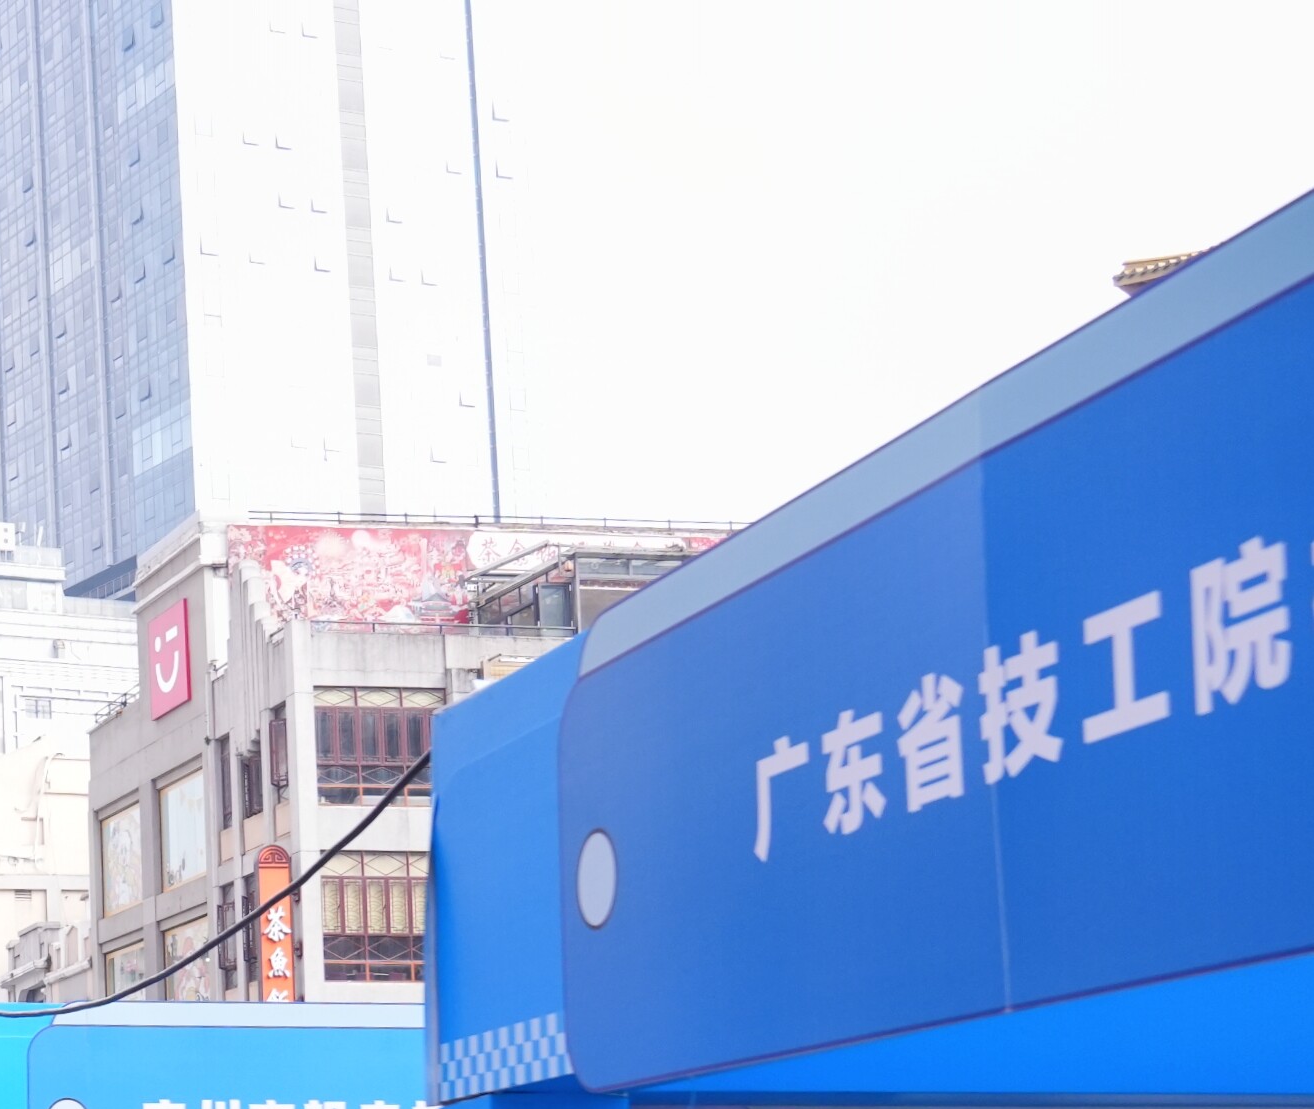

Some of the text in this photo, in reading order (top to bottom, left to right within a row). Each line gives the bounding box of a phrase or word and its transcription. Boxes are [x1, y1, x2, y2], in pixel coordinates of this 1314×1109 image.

[754, 536, 1314, 863] 广东省技工院
